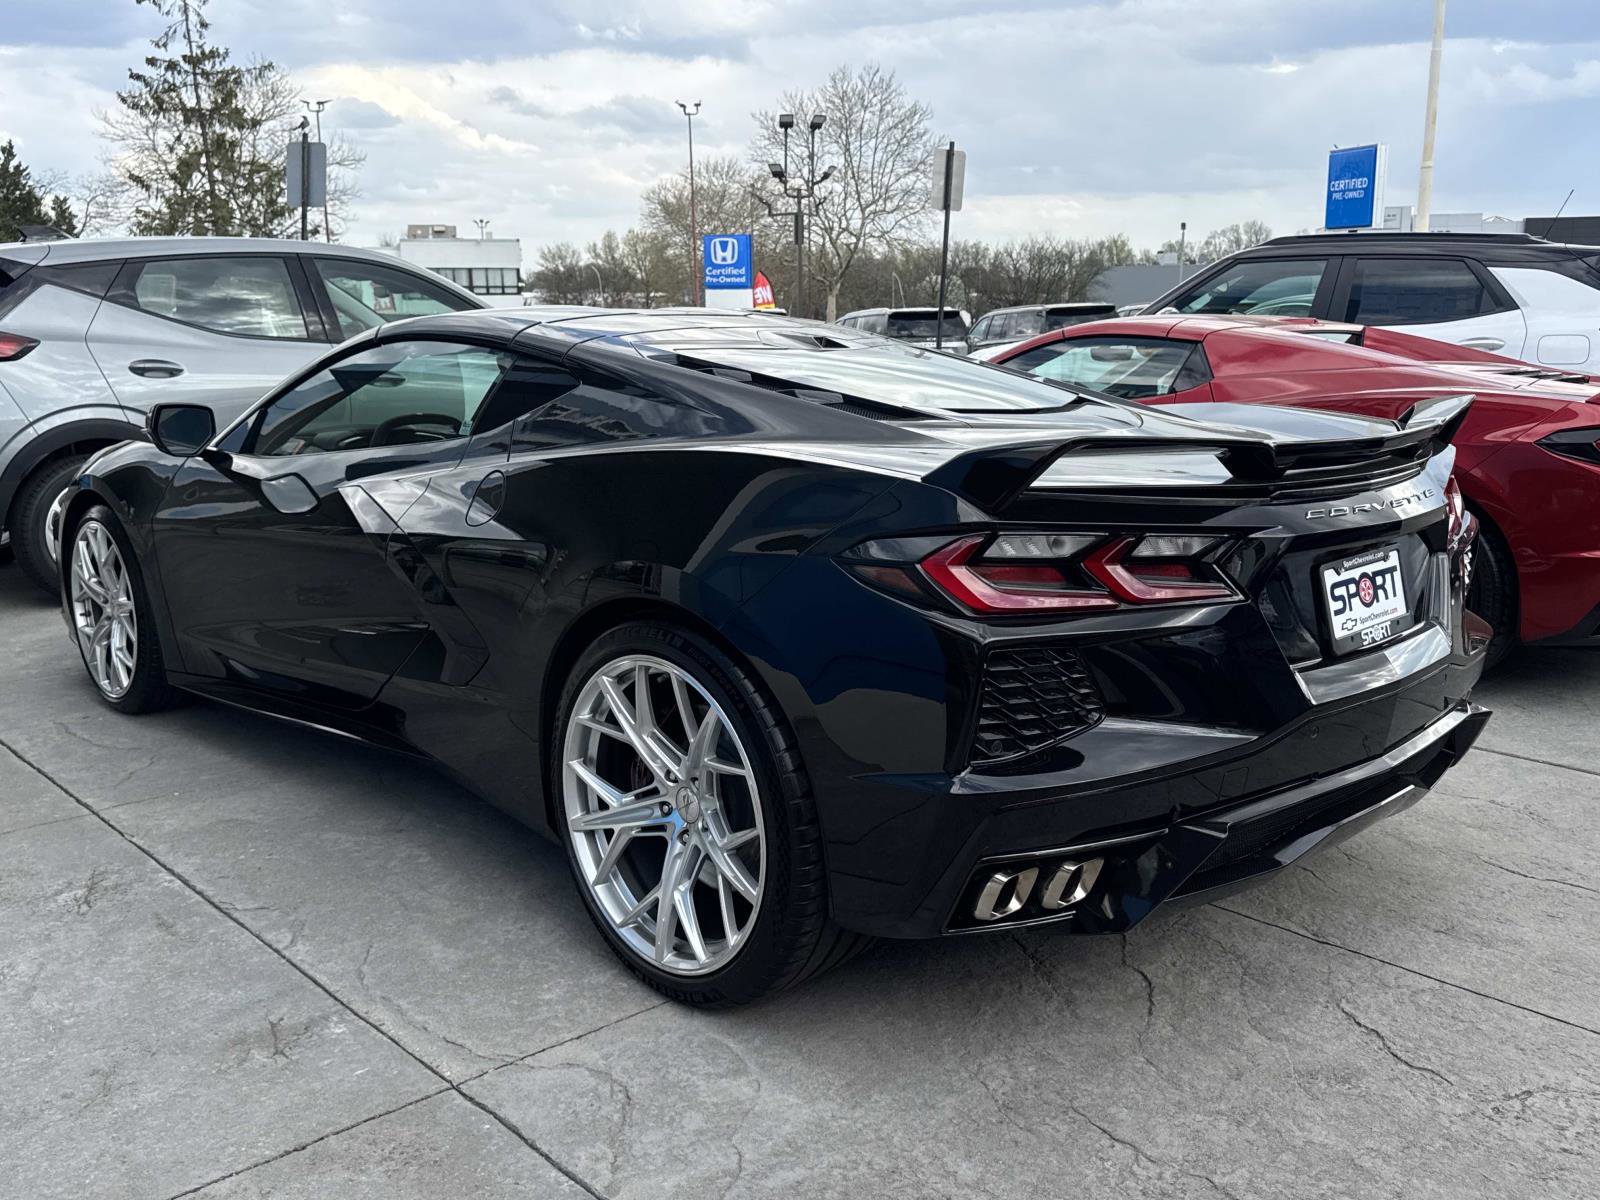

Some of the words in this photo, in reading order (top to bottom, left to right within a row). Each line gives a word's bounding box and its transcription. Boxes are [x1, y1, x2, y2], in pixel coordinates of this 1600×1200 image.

[1330, 177, 1368, 191] CERTIFIED
[1332, 190, 1364, 200] PRE-OWNED
[706, 266, 746, 275] Certified
[1305, 488, 1435, 520] CORVETTE
[1343, 551, 1384, 568] SportChevrolet.com
[1330, 565, 1398, 616] SPORT
[1359, 607, 1398, 625] SportChevrolet.com
[1361, 621, 1392, 645] SPORT
